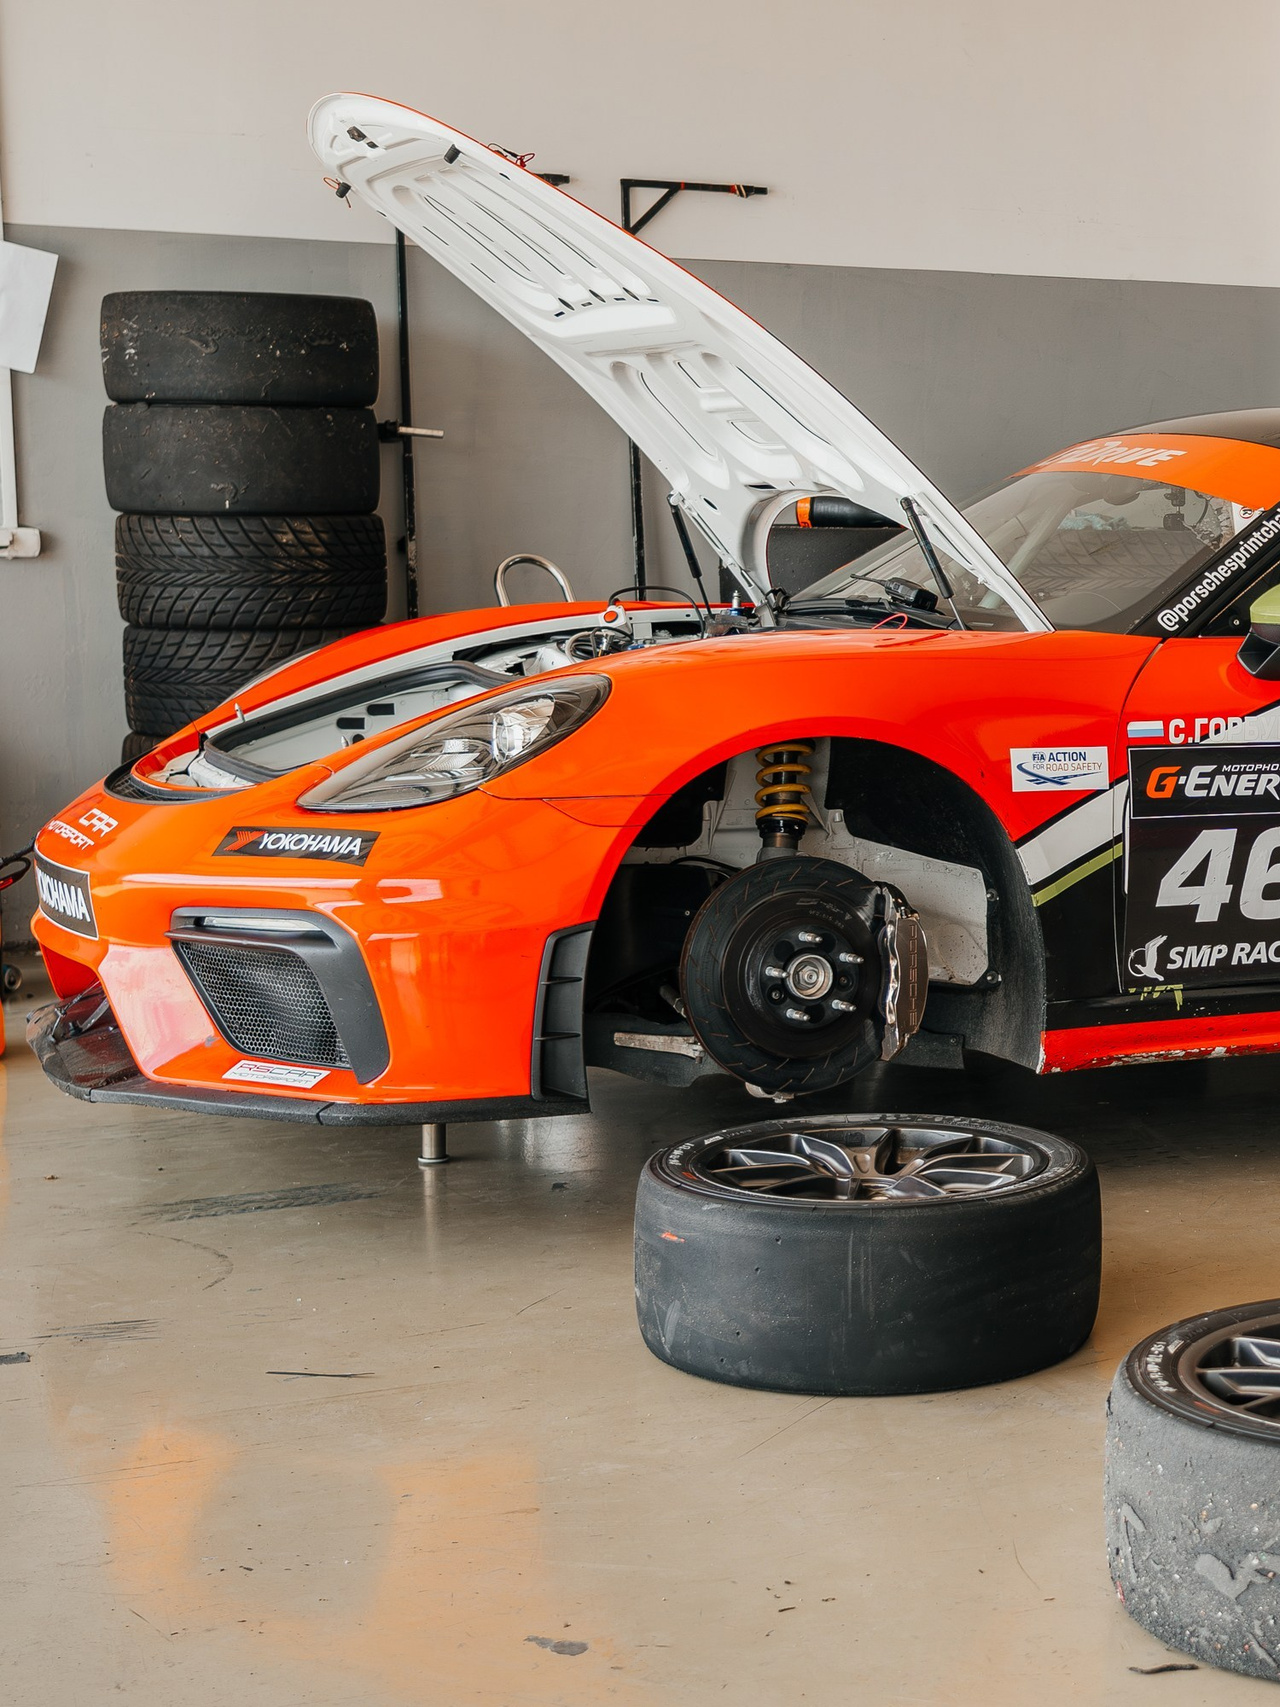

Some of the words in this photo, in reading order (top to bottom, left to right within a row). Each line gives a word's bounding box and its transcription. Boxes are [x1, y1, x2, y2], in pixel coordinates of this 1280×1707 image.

[1046, 763, 1069, 772] ROAD
[1071, 762, 1103, 772] SAFETY
[1047, 751, 1087, 762] ACTION
[47, 819, 95, 850] OTORSPORT
[258, 831, 363, 856] YOKOHAMA
[36, 866, 91, 923] OKOHAMA
[1166, 944, 1228, 970] SMP
[909, 924, 918, 1027] PORSCHE
[229, 1071, 312, 1085] MOTORSPORT
[237, 1062, 322, 1079] RSCAR
